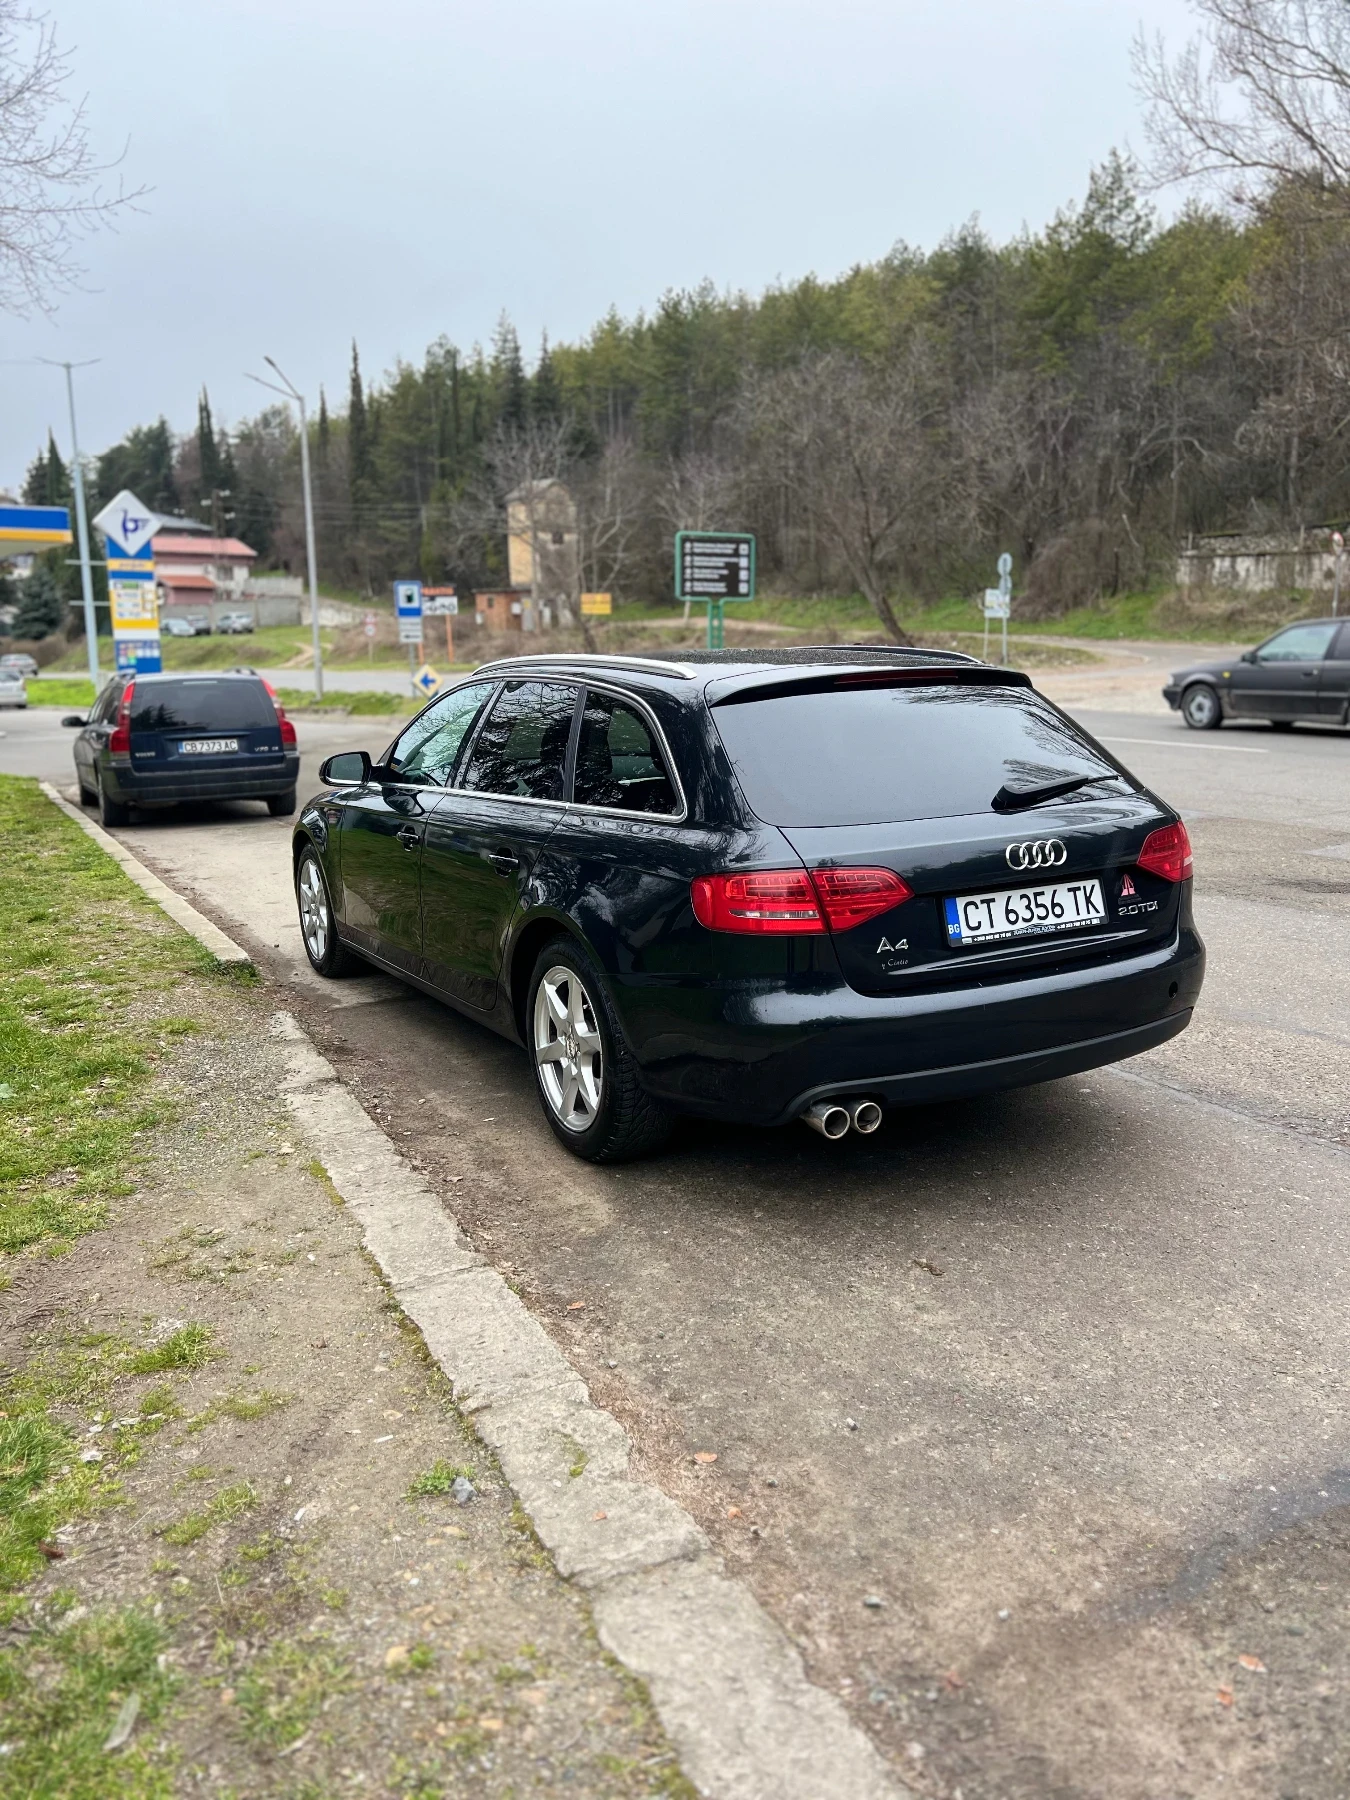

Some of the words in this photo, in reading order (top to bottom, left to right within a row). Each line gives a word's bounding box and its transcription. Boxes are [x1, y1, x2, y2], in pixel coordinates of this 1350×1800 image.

[184, 742, 197, 752] CB
[198, 741, 222, 751] 7373
[224, 740, 237, 750] AC
[963, 897, 996, 931] CT
[1004, 889, 1065, 925] 6356
[1067, 884, 1101, 916] TK
[948, 923, 961, 934] BG
[876, 936, 909, 954] A4
